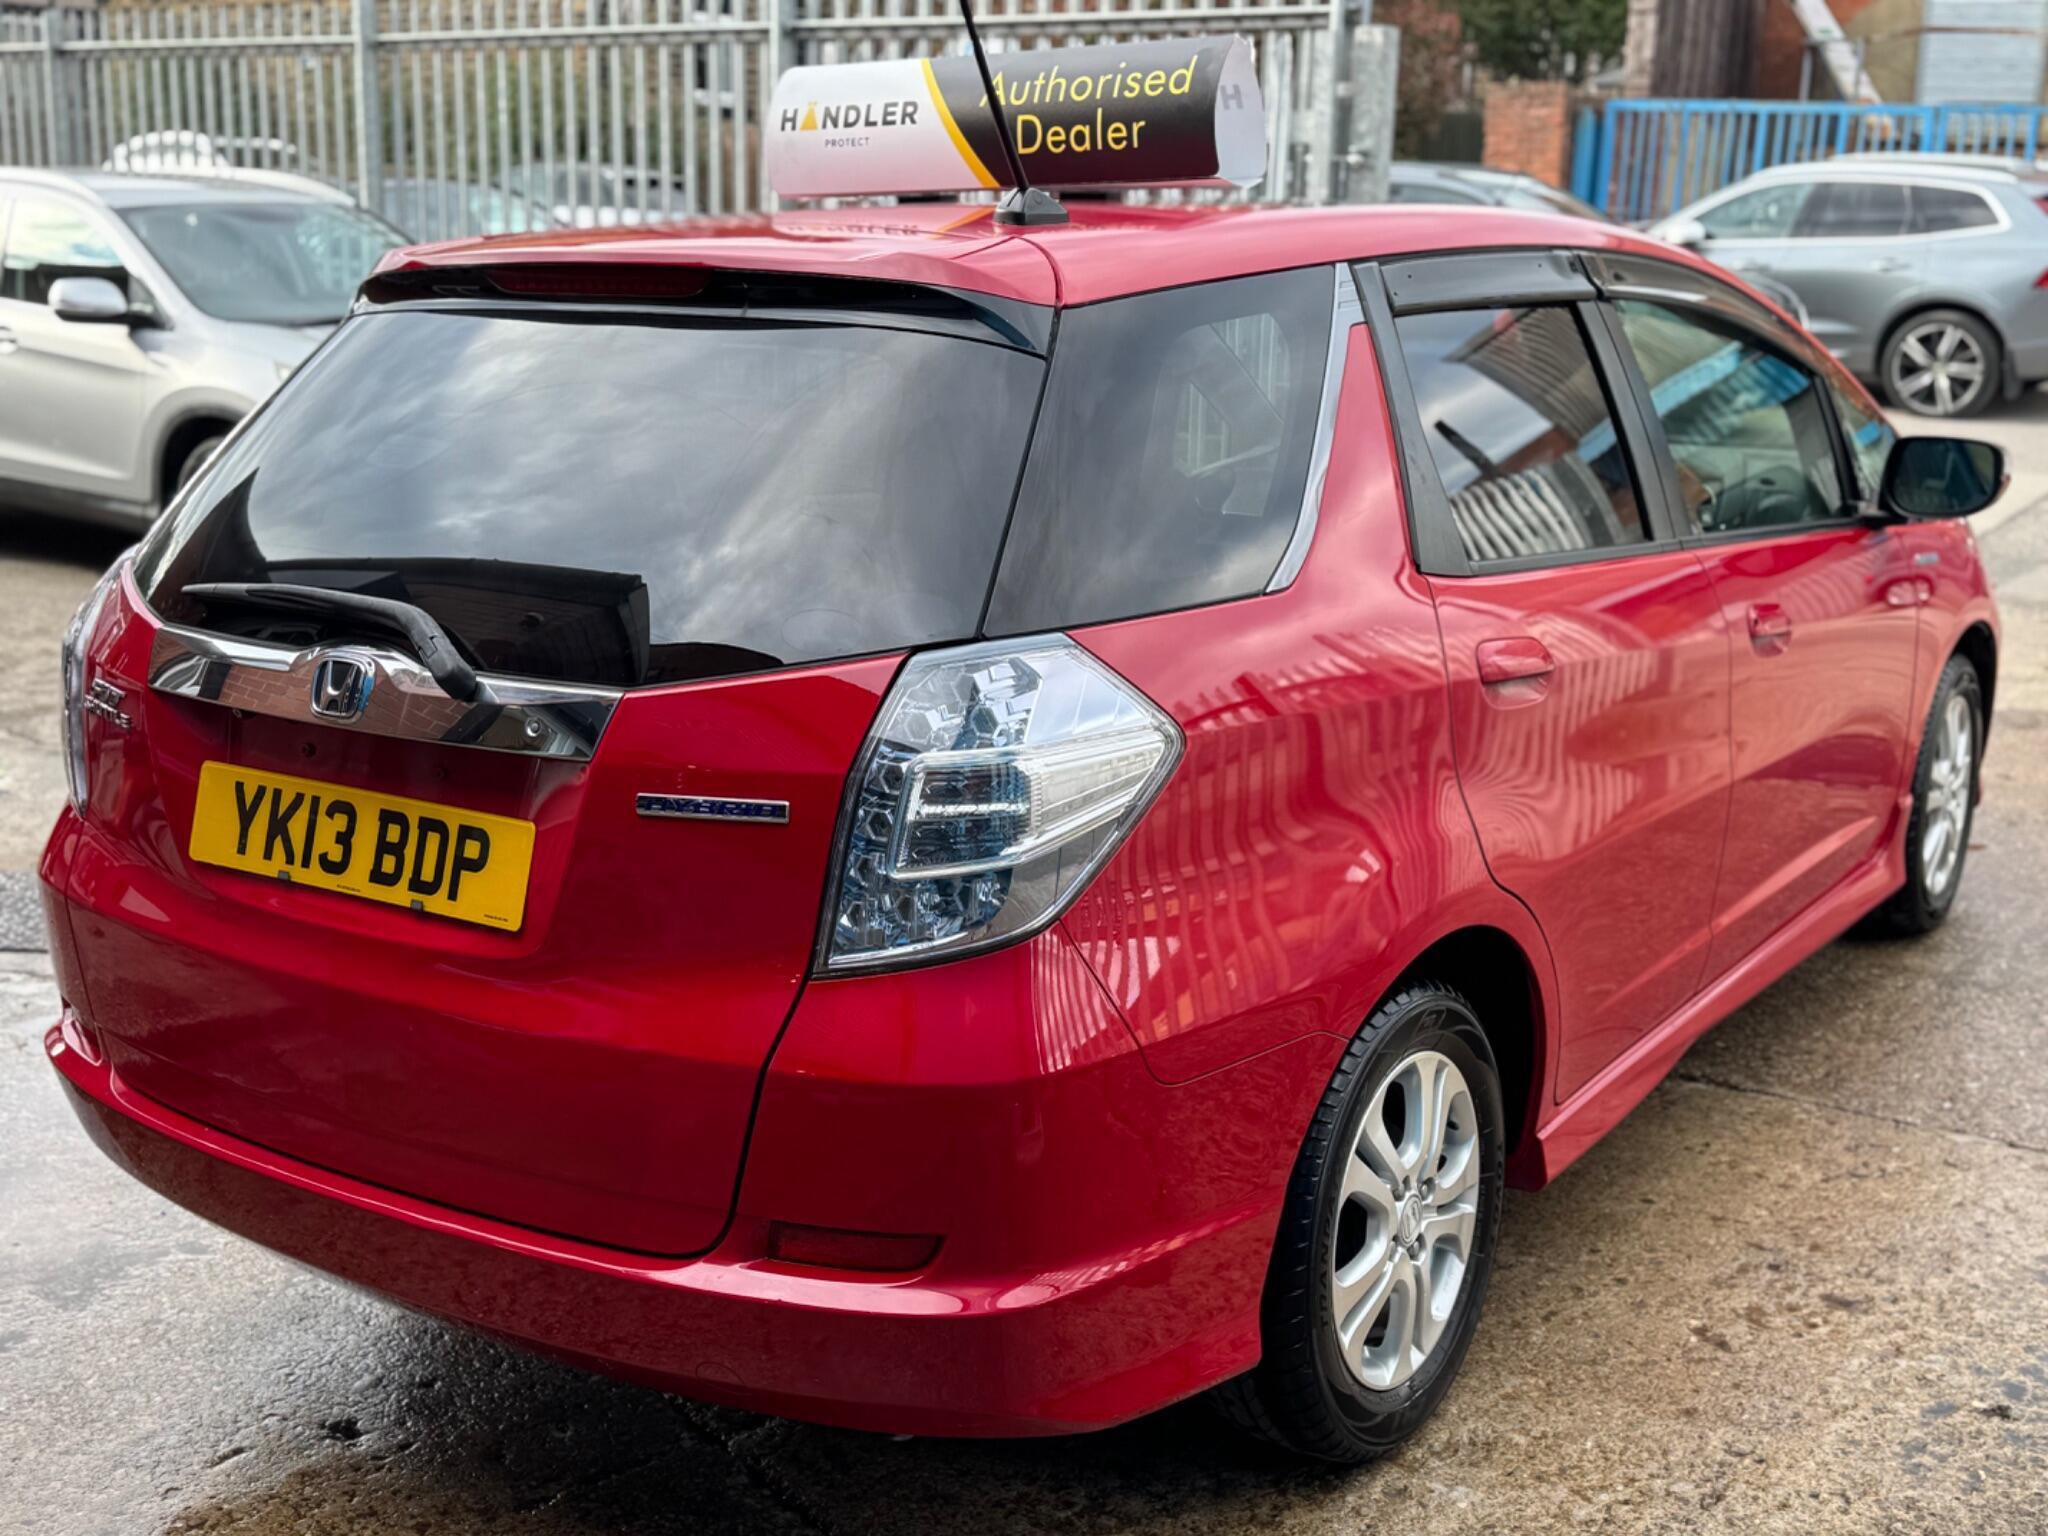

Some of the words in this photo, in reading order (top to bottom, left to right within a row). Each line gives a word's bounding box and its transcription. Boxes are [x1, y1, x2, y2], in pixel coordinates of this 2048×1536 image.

[979, 54, 1199, 107] Authorised
[824, 136, 870, 148] PROTECT
[1016, 107, 1146, 154] Dealer
[234, 780, 358, 876] YK13
[368, 808, 491, 902] BDP
